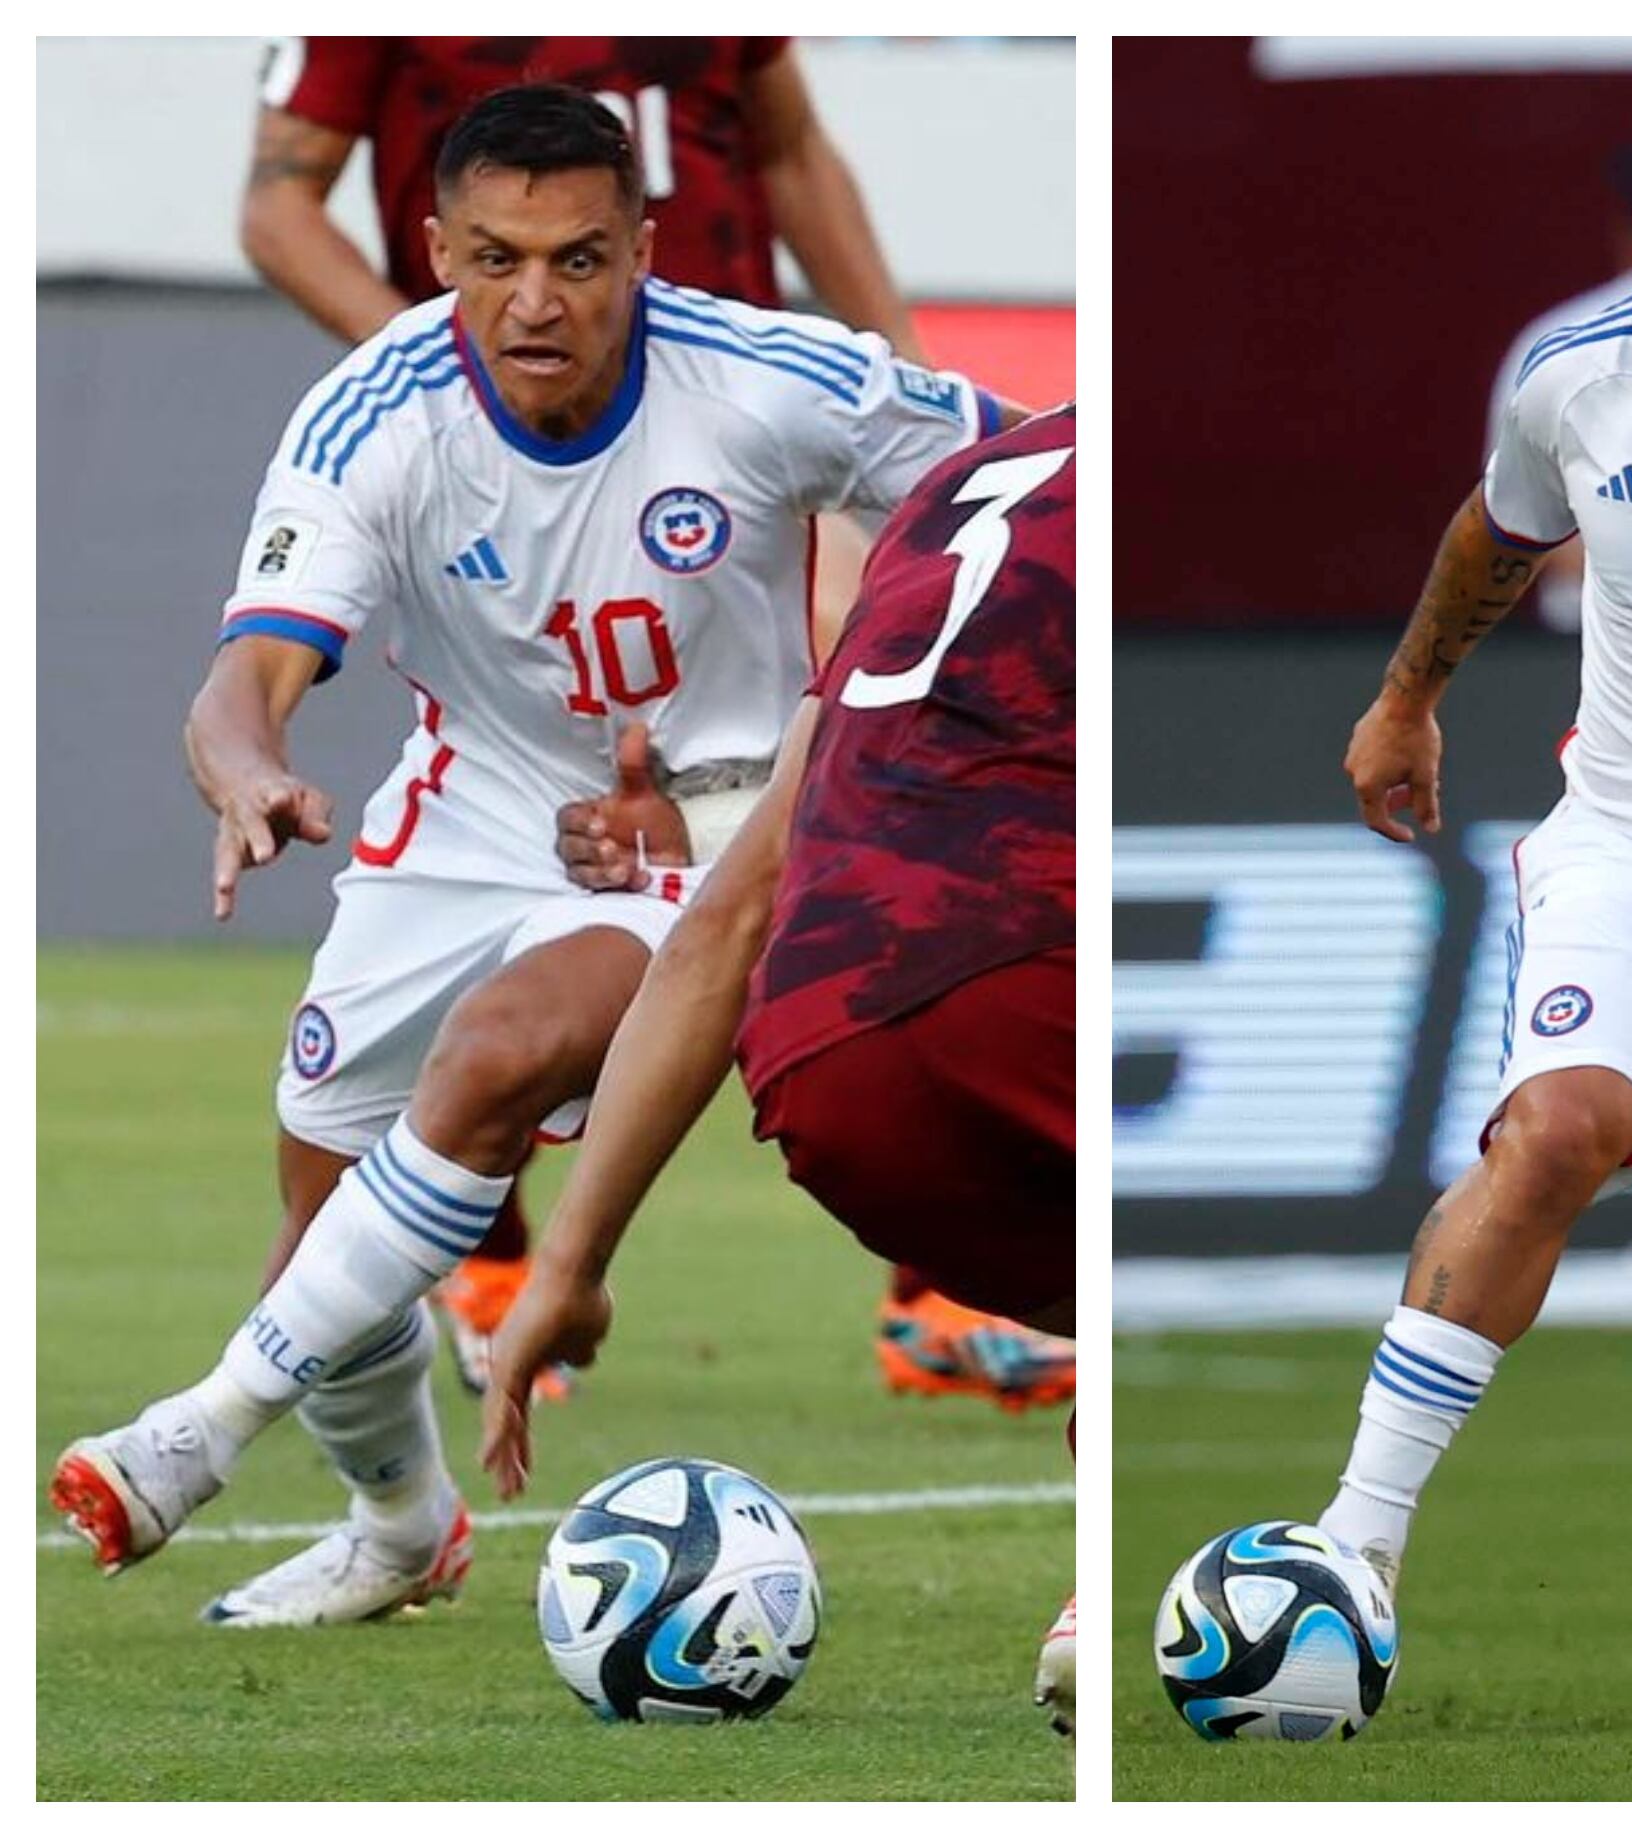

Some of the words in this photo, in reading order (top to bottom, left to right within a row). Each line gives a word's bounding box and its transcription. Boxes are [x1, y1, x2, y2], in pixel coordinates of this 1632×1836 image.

[593, 84, 674, 198] 1
[839, 447, 1075, 708] 3
[544, 598, 680, 716] 10
